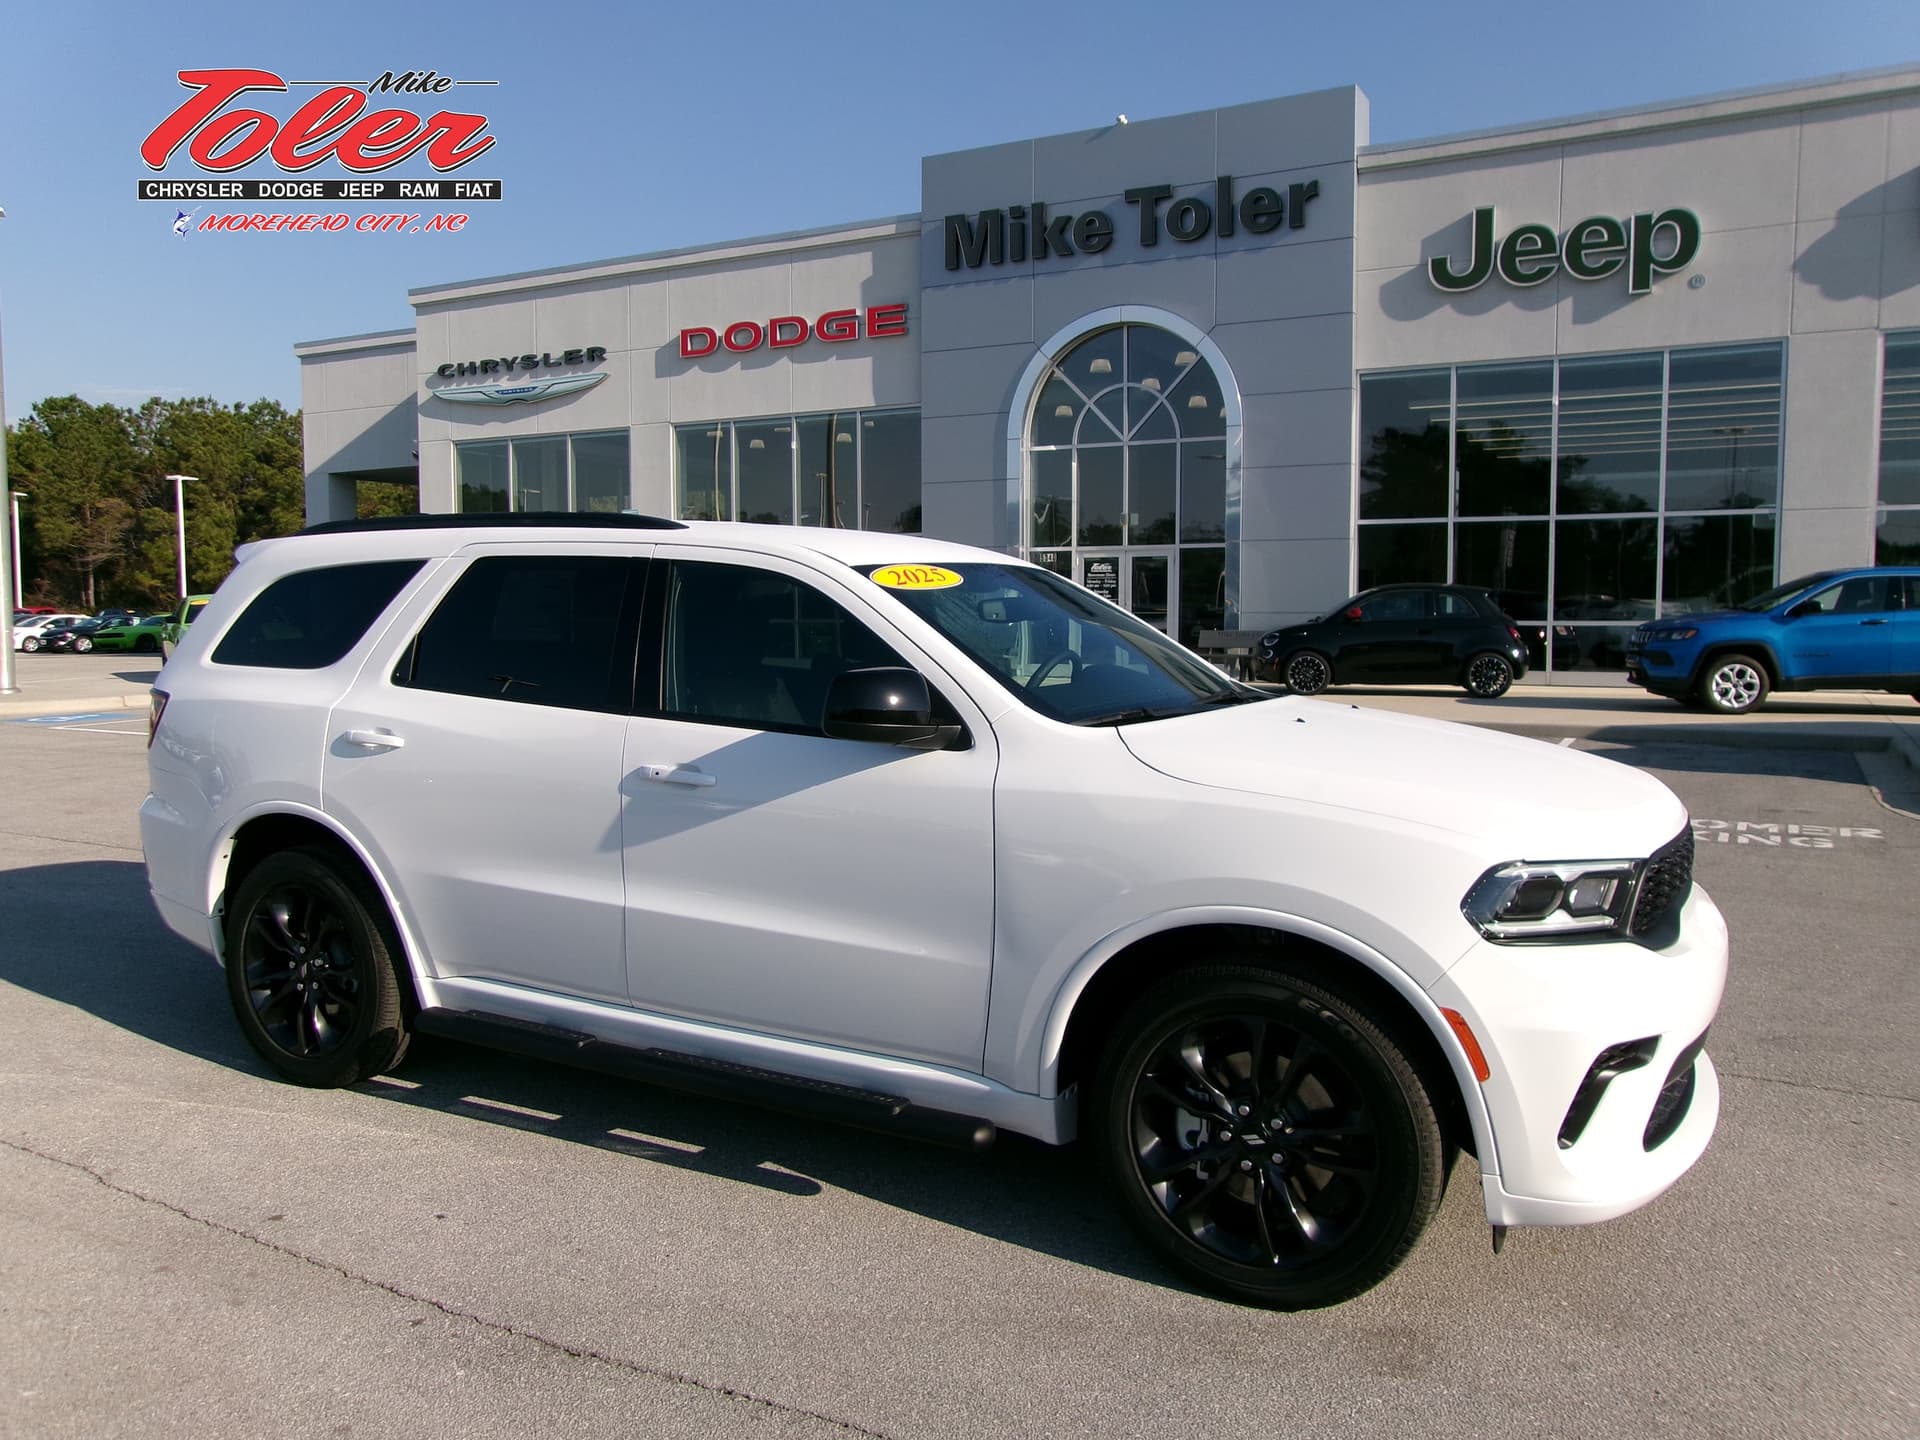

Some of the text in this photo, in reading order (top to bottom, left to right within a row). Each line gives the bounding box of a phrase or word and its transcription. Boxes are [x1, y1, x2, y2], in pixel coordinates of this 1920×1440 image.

[944, 174, 1319, 270] Mike Toler
[1427, 204, 1702, 295] Jeep
[679, 303, 908, 359] DODGE
[437, 345, 608, 380] CHRYSLER
[888, 568, 946, 586] 2025
